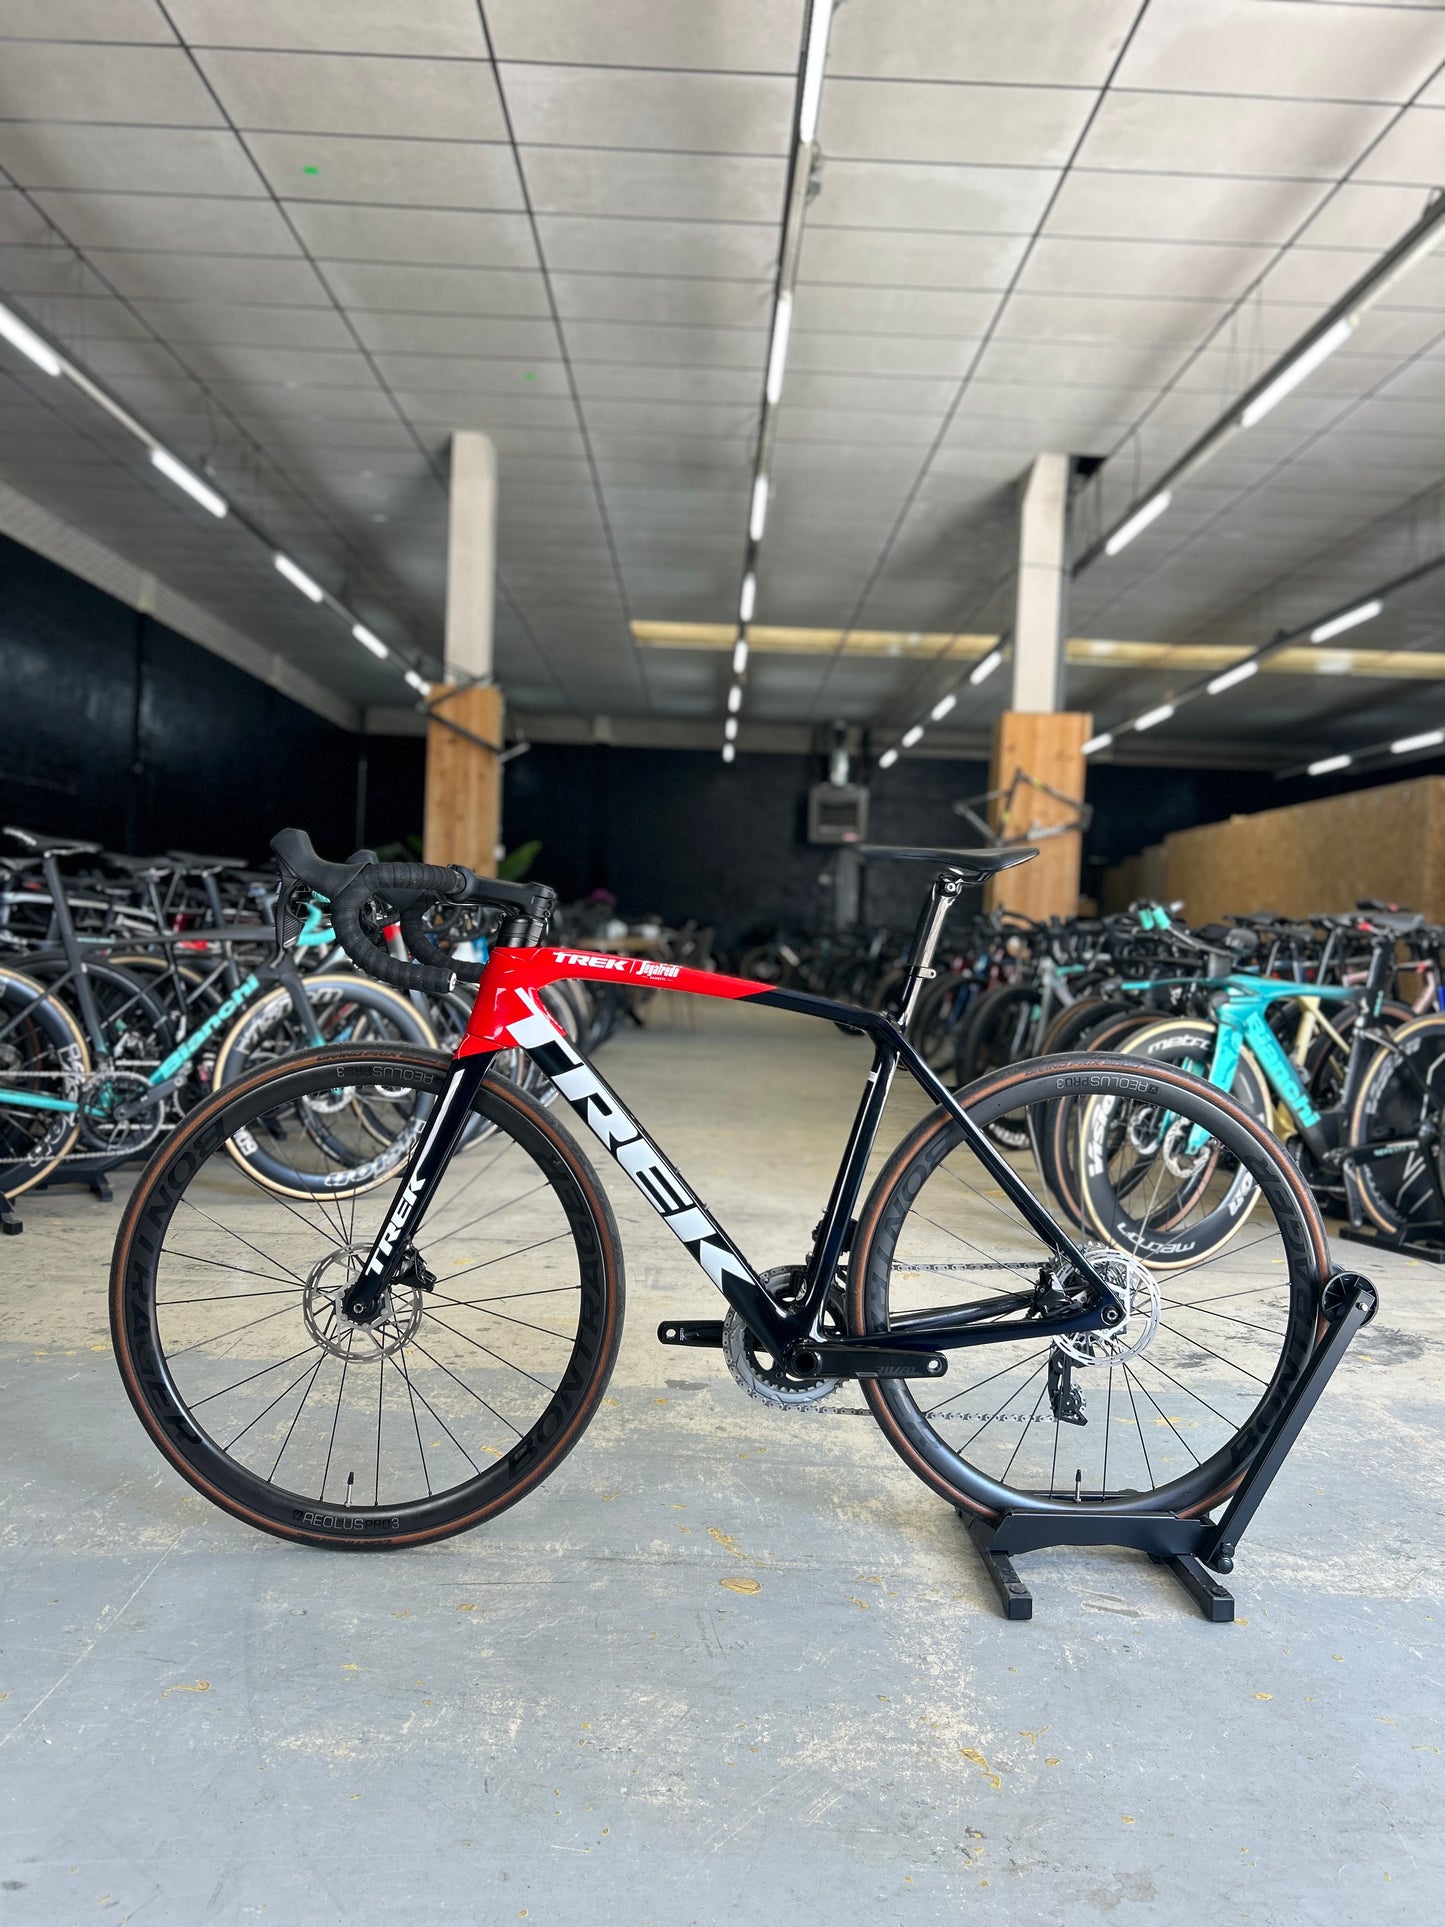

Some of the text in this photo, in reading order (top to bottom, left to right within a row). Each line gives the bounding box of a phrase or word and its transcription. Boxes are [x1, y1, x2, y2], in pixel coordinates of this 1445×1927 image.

[553, 952, 629, 971] TREK
[1148, 1034, 1211, 1054] metr
[505, 986, 756, 1292] TREK
[365, 1174, 426, 1277] TREK
